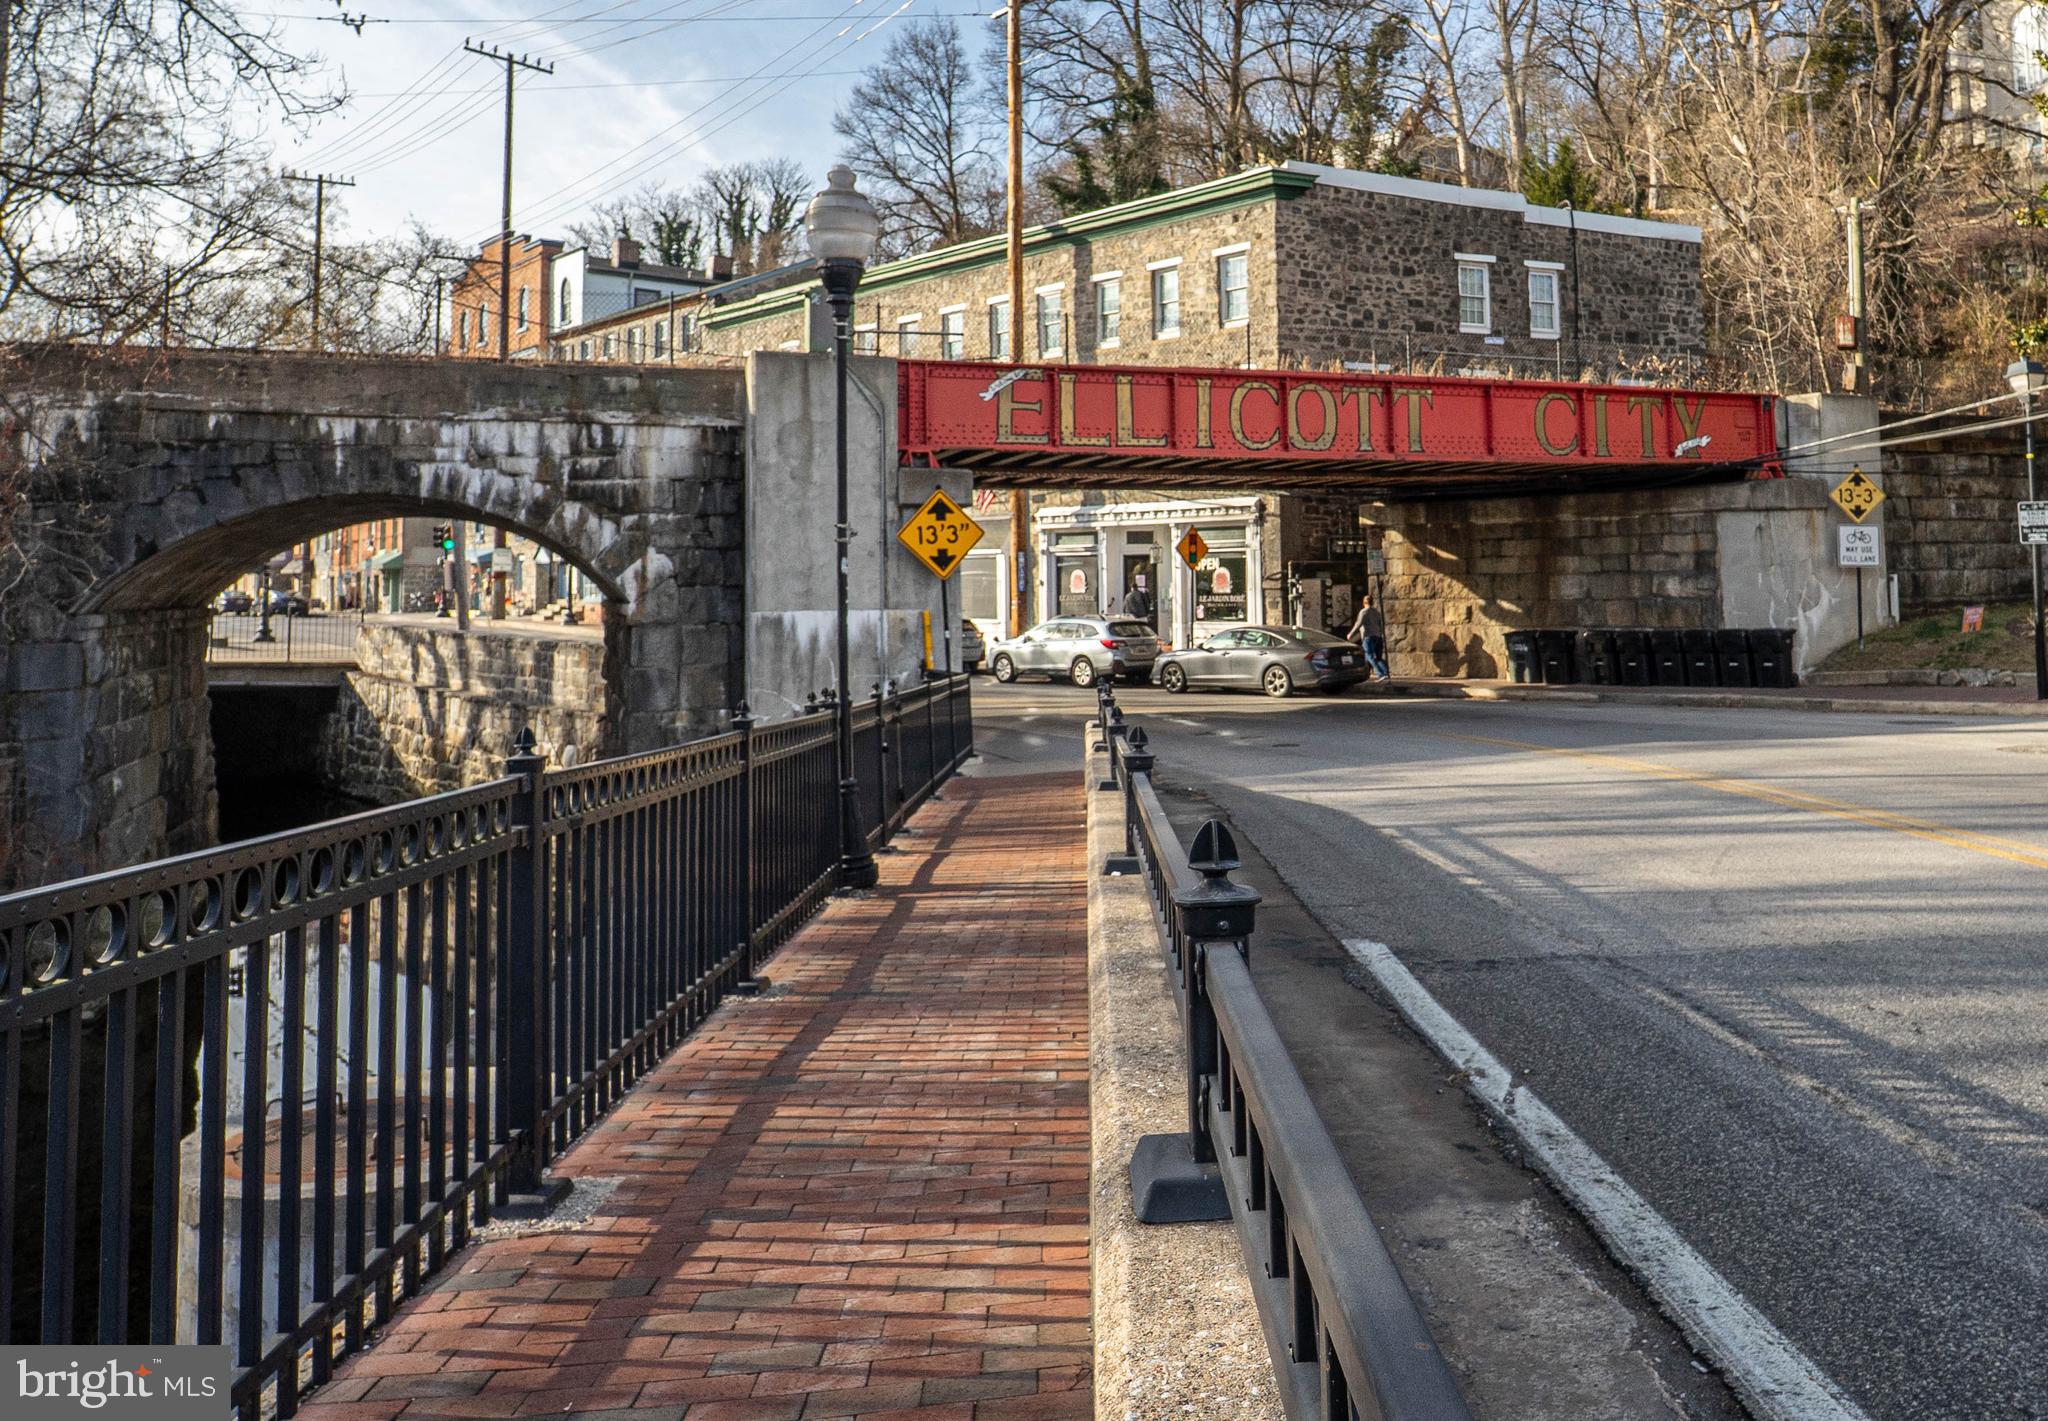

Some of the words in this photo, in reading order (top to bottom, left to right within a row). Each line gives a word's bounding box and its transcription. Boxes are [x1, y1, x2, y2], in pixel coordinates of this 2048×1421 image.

[995, 368, 1434, 452] ELLICOTT
[1534, 392, 1707, 458] CITY
[1860, 555, 1876, 563] LANE
